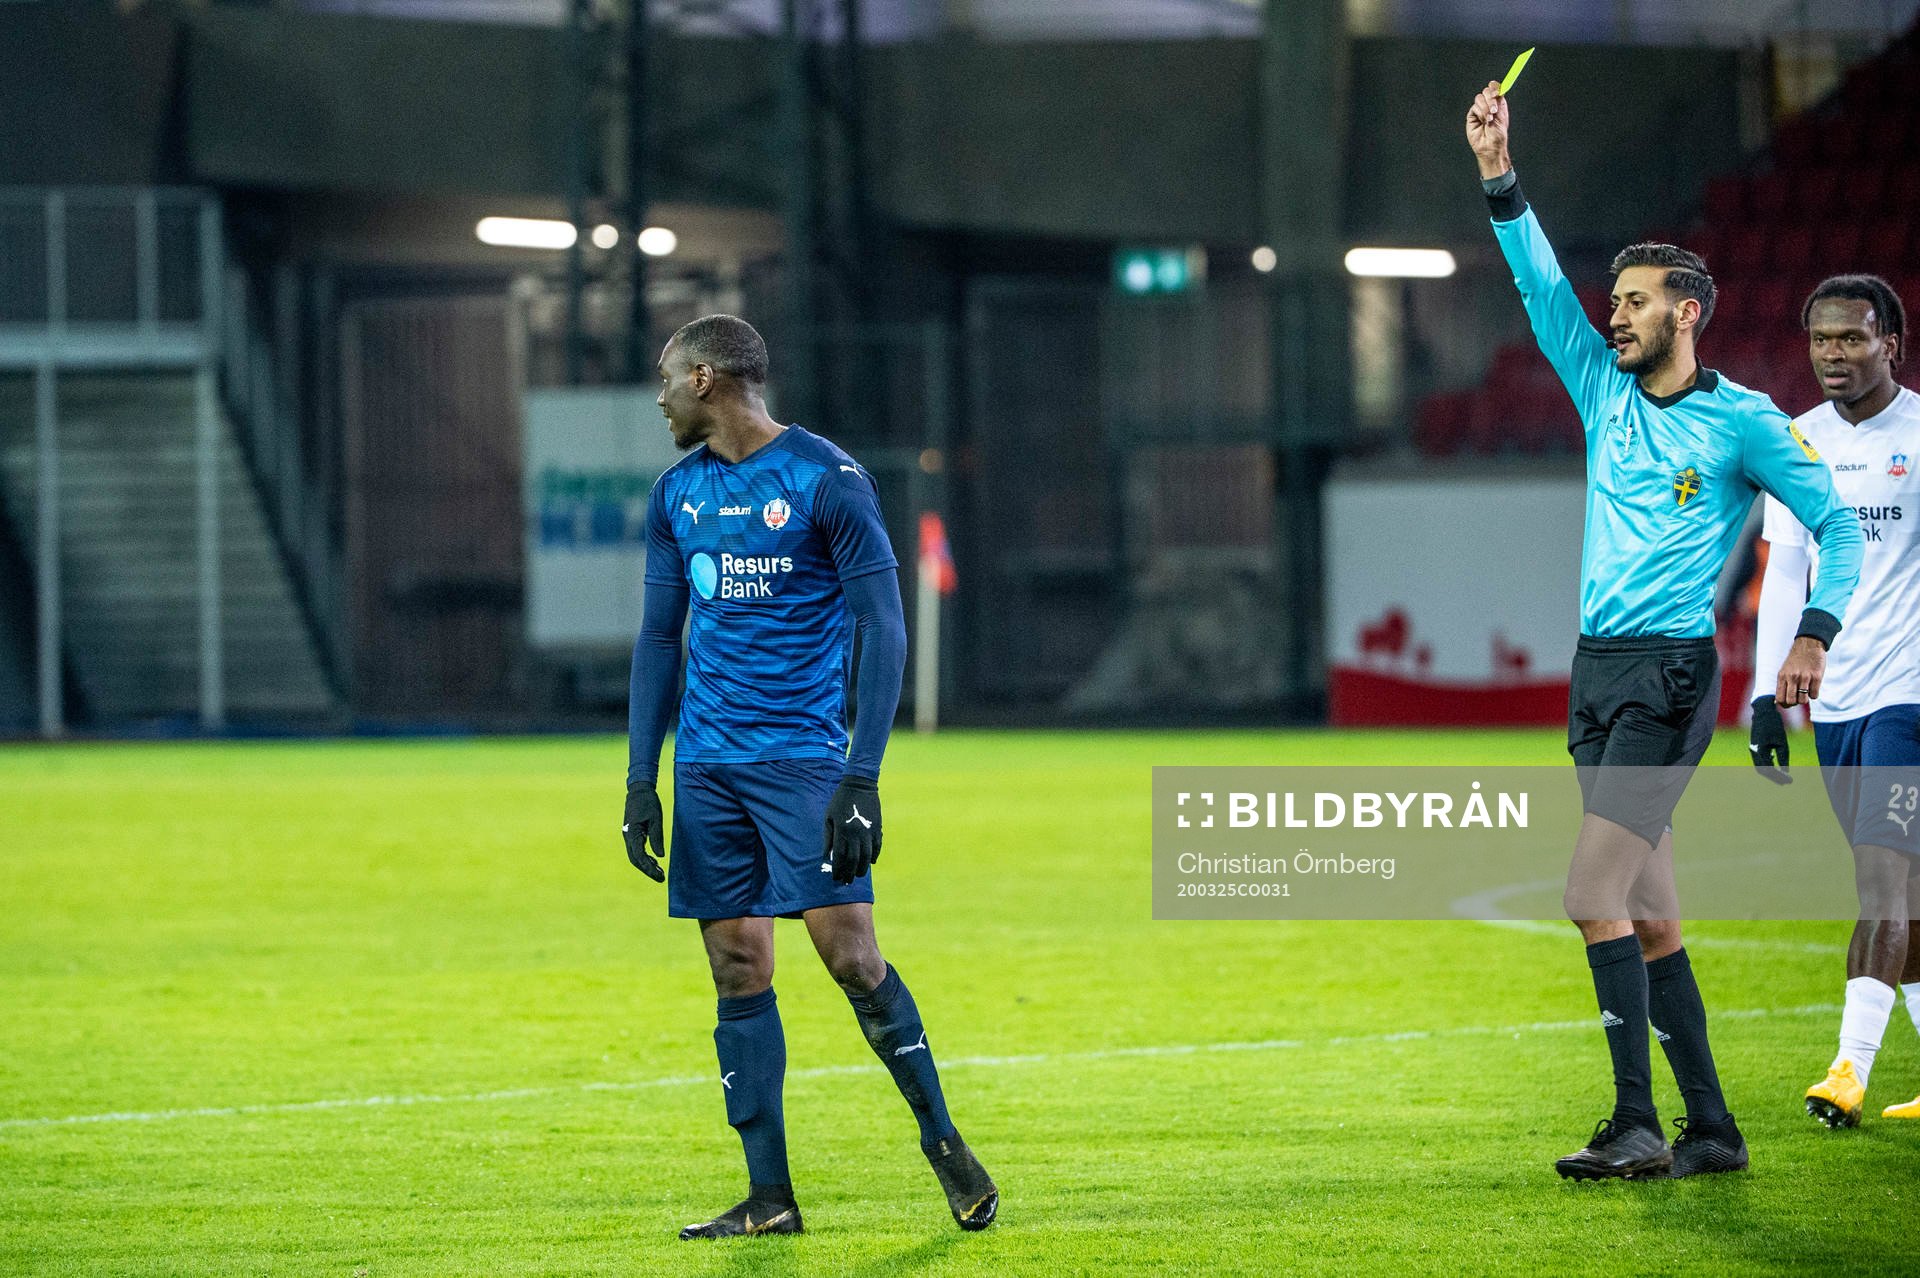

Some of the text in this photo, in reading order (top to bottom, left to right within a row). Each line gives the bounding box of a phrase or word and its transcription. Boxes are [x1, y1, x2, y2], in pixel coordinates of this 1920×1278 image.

[1835, 463, 1867, 472] stadium
[718, 505, 752, 516] stadium
[1852, 505, 1902, 520] surs
[721, 552, 793, 575] Resurs
[721, 576, 773, 599] Bank
[1888, 783, 1919, 812] 23
